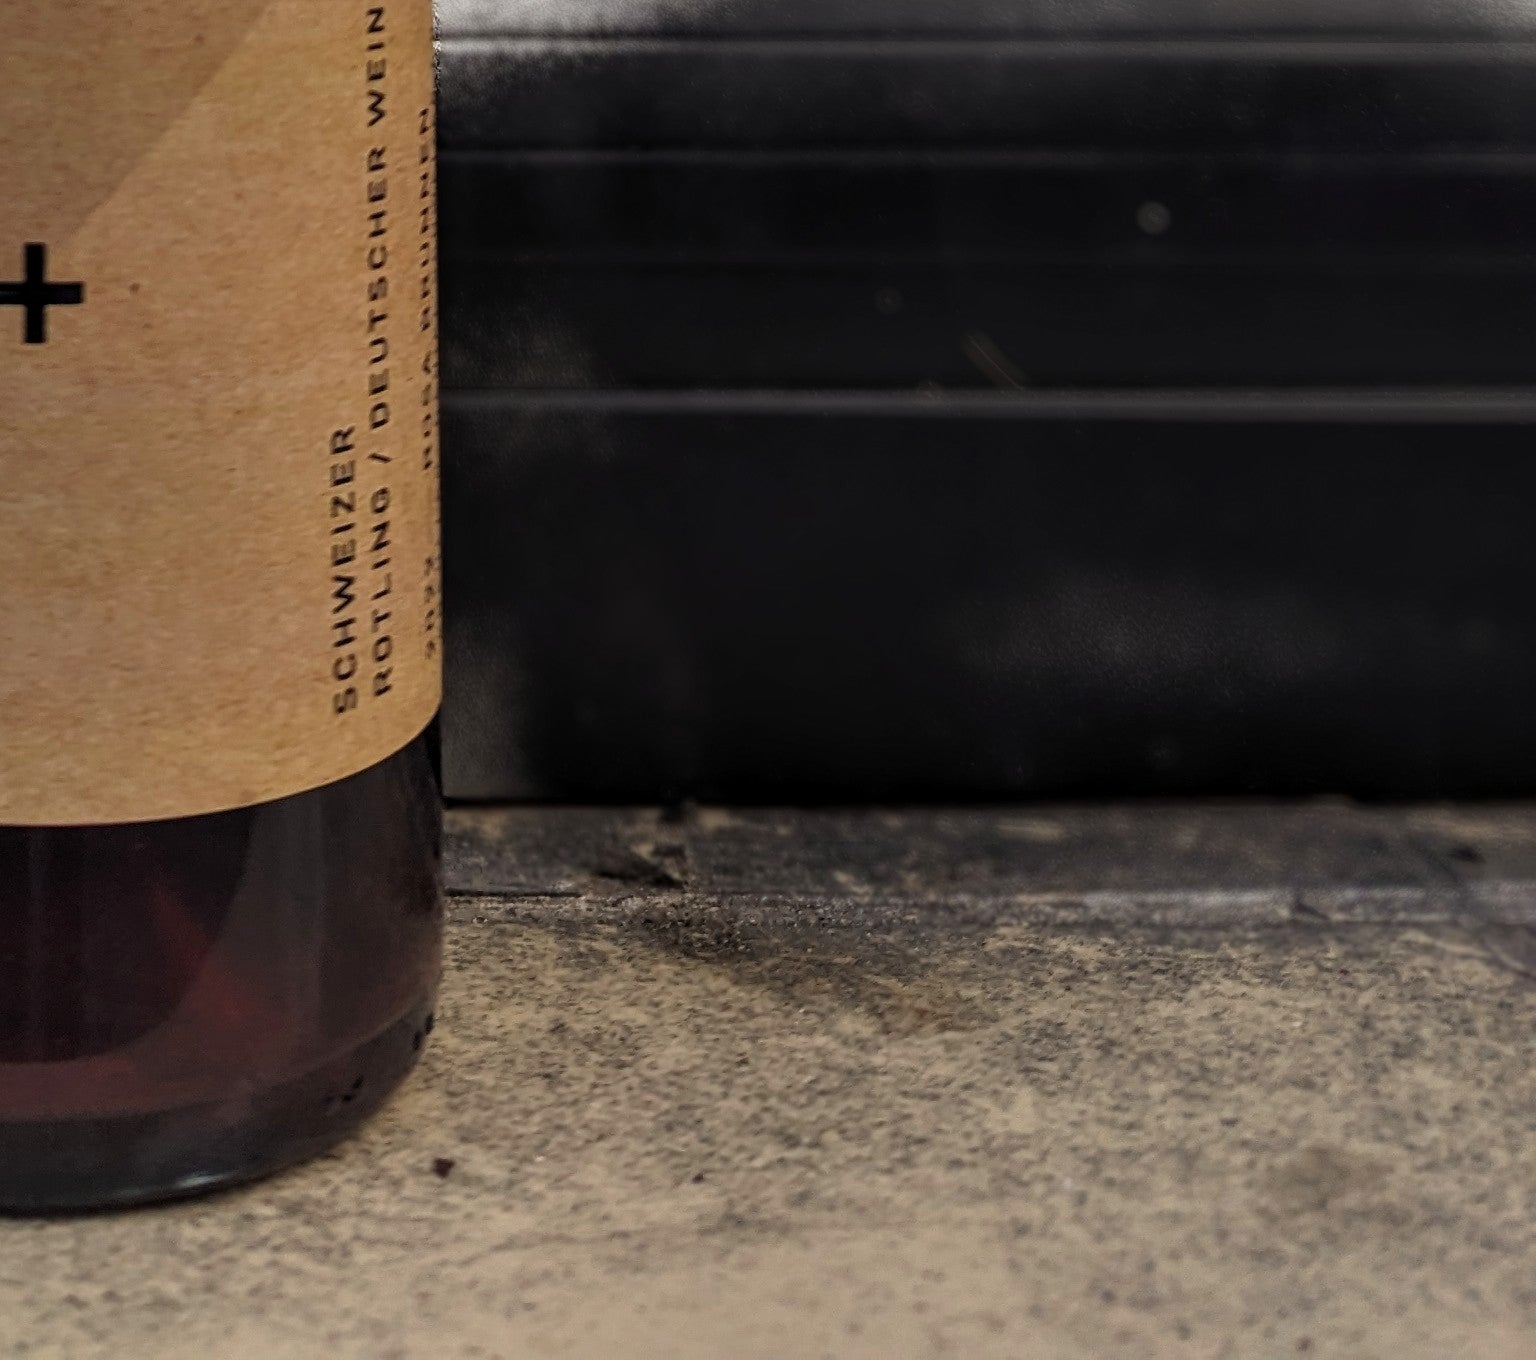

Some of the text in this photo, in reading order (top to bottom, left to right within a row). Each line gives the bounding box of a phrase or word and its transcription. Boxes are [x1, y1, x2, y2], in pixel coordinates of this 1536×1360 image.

[365, 6, 387, 129] WEIN
[367, 145, 391, 430] DEUTSCHER
[332, 426, 357, 713] SCHWEIZER
[370, 485, 393, 697] ROTLING
